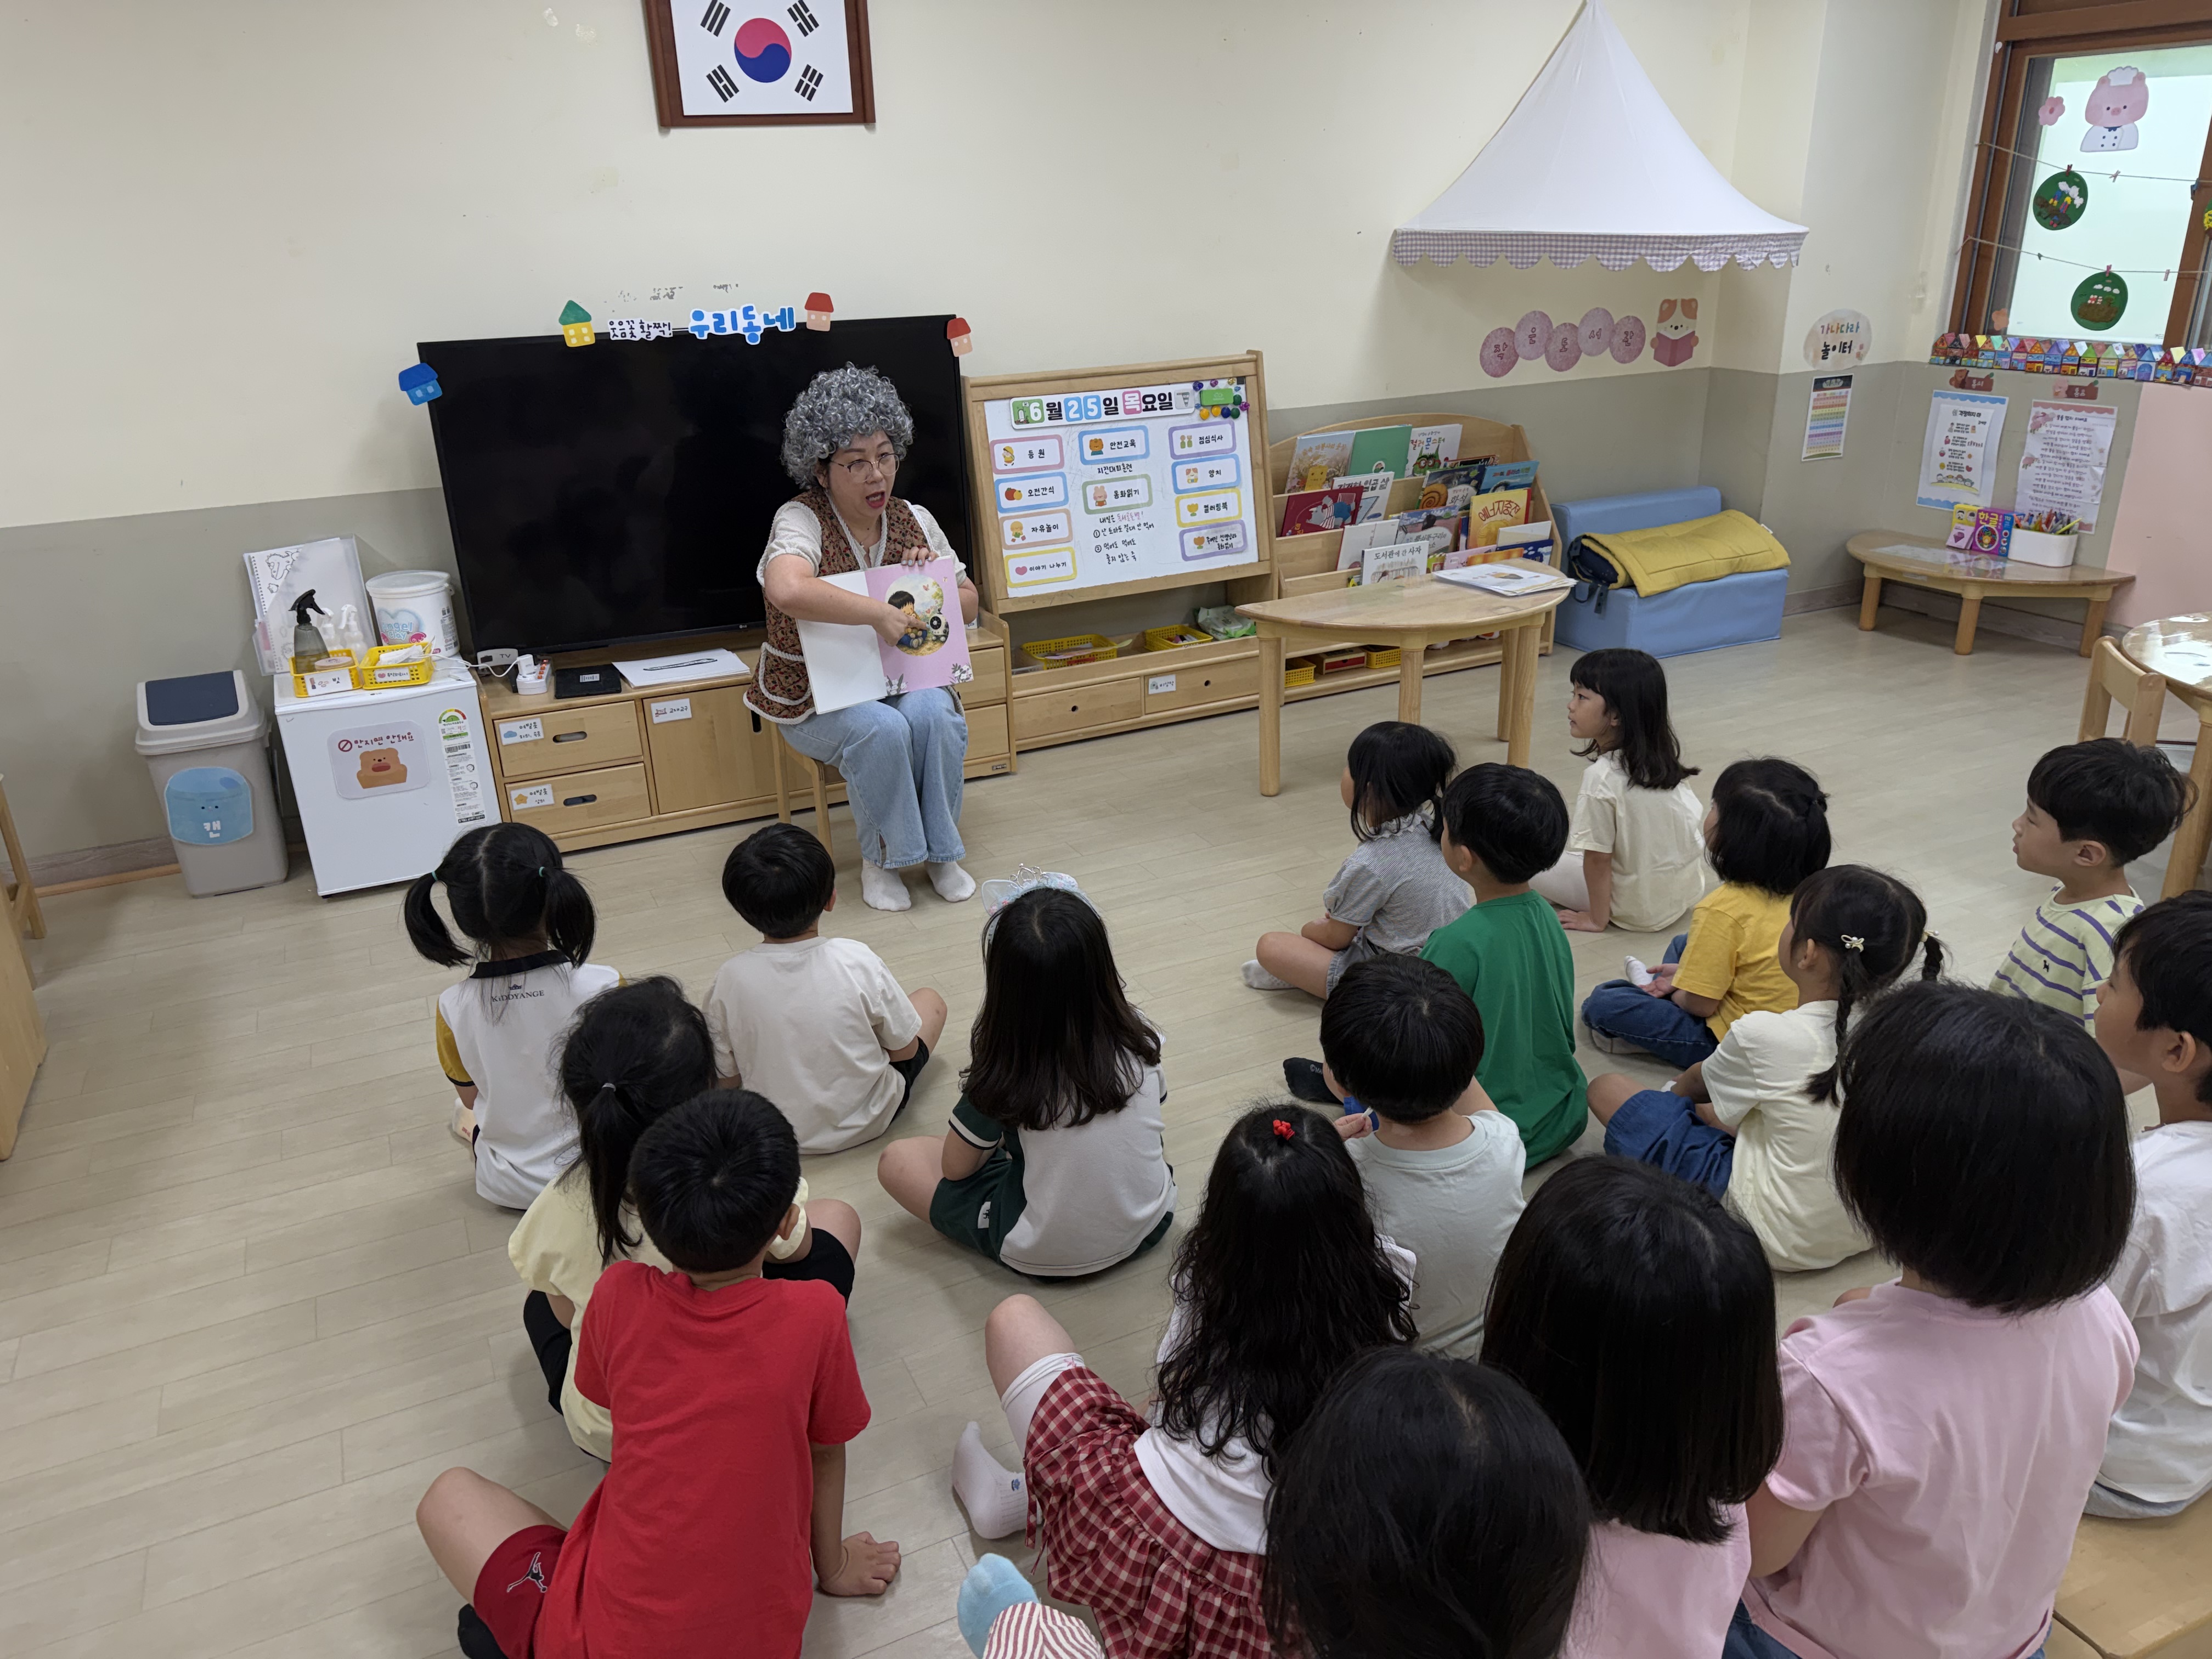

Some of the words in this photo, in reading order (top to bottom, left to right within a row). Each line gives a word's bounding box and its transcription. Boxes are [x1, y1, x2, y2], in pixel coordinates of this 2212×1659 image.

[608, 320, 637, 339] 웃음꽃
[639, 319, 673, 339] 활짝!
[1820, 321, 1860, 335] 가나다라
[1821, 340, 1853, 360] 놀이터
[1029, 400, 1064, 421] 6월
[1067, 396, 1119, 419] 25일
[1124, 391, 1173, 414] 목요일
[1110, 439, 1136, 450] 안전교육
[1199, 434, 1223, 445] 점심식사
[1425, 437, 1446, 450] 몬스터
[1097, 462, 1133, 475] 지진대피훈련
[1208, 469, 1222, 478] 양치
[1028, 486, 1054, 497] 오전간식
[1113, 488, 1139, 499] 동화읽기
[1203, 501, 1228, 514] 컬러링북
[1099, 514, 1116, 523] 내일은
[1978, 511, 1999, 528] 한글
[1031, 523, 1059, 533] 자유놀이
[1108, 525, 1123, 534] 토마토
[1124, 523, 1136, 533] 절대
[1143, 522, 1154, 531] 먹어
[1103, 541, 1119, 550] 먹어도
[1121, 538, 1137, 548] 먹어도
[1374, 549, 1400, 560] 도서관에
[1408, 545, 1422, 556] 사자
[519, 721, 538, 730] 여벌옷
[354, 736, 383, 748] 만지면
[529, 788, 548, 796] 여벌옷
[203, 820, 221, 838] 캔
